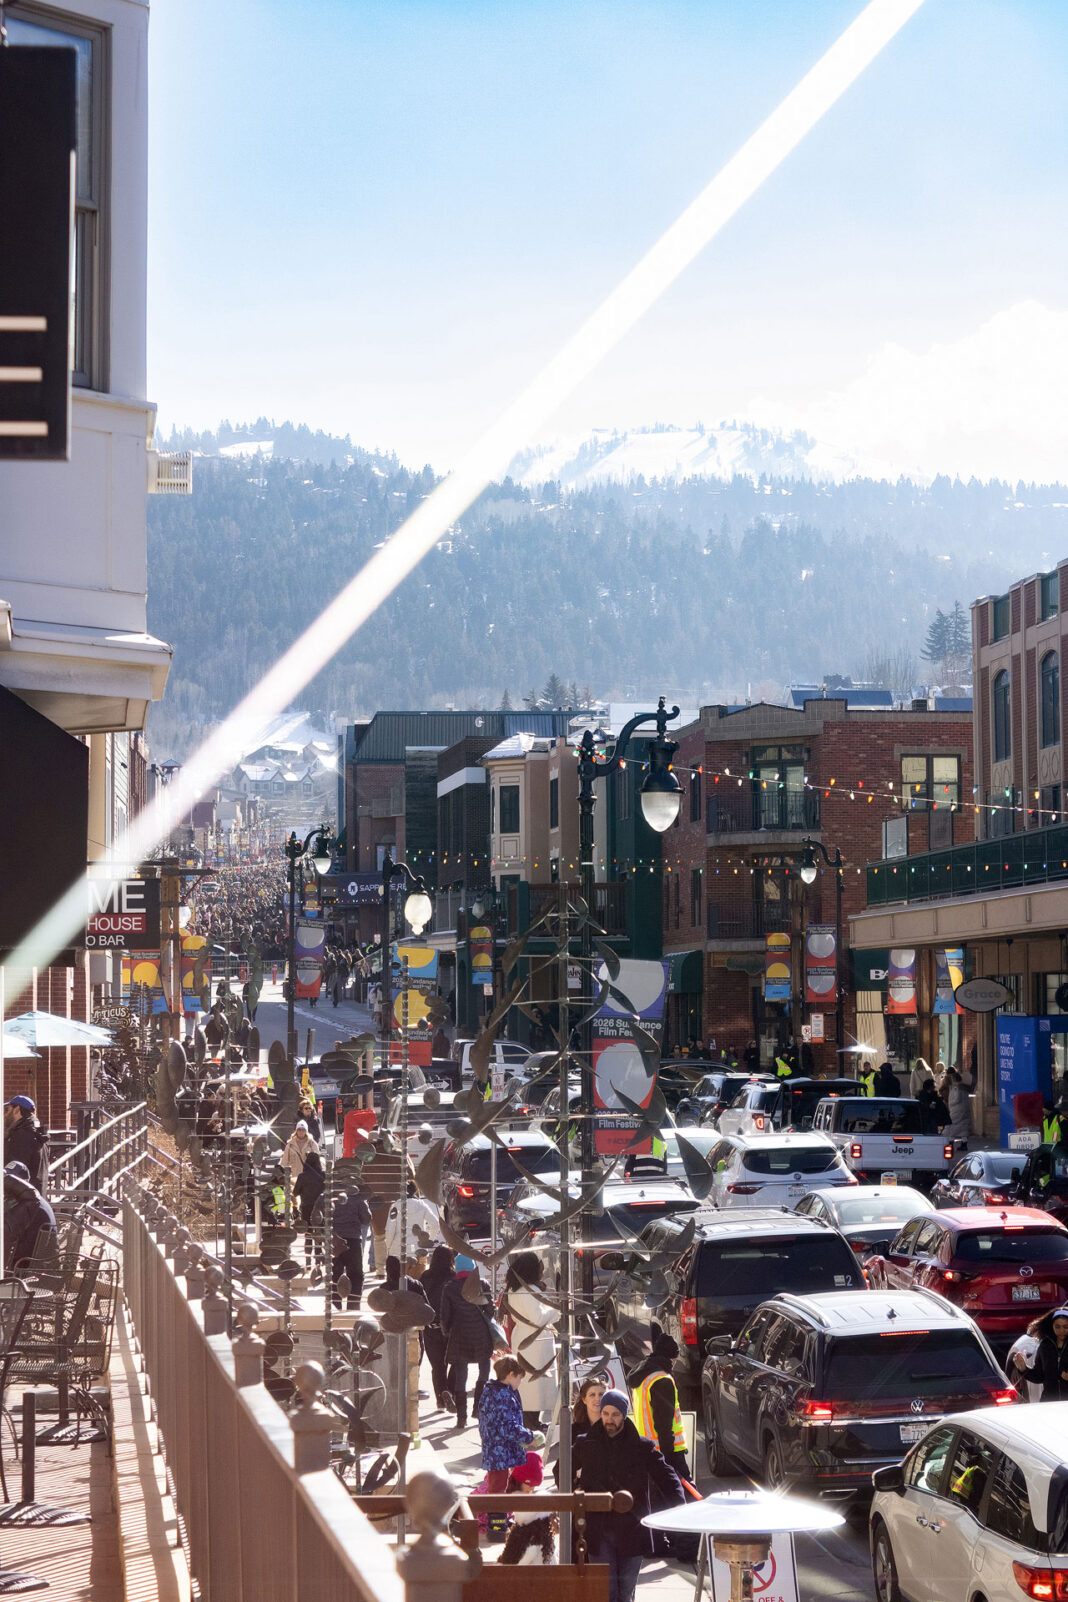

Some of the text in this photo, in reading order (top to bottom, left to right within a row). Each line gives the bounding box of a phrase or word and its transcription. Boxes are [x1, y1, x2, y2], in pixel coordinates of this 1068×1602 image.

[87, 917, 143, 931] HOUSE
[98, 935, 125, 946] BAR
[593, 1018, 614, 1027] 2026
[598, 1027, 654, 1038] Film Fesal
[598, 1120, 641, 1129] Film Festiv
[892, 1146, 914, 1155] Jeep
[845, 1275, 853, 1287] 2
